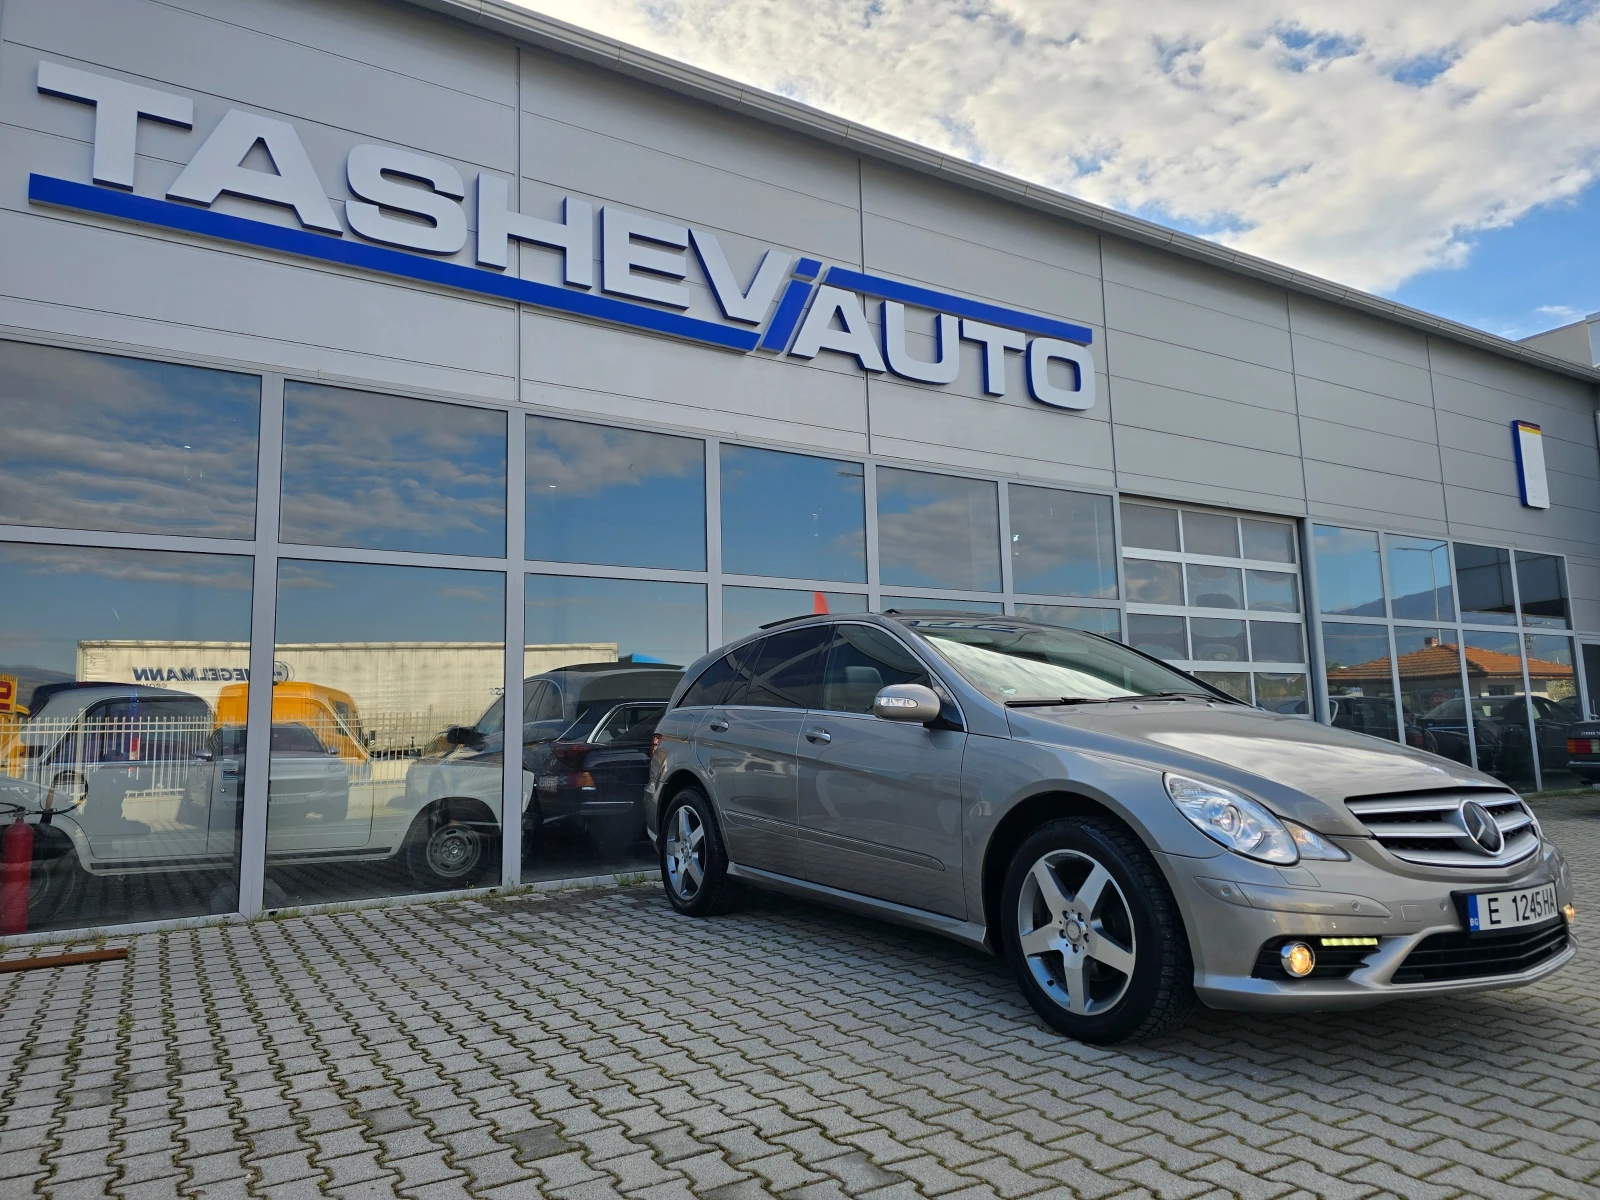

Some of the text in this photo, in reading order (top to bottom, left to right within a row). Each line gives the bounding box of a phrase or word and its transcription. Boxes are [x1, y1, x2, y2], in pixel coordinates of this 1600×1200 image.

[37, 59, 1095, 410] TASHEV AUTO
[1470, 918, 1479, 926] BG
[1487, 888, 1556, 925] E 1245HA
